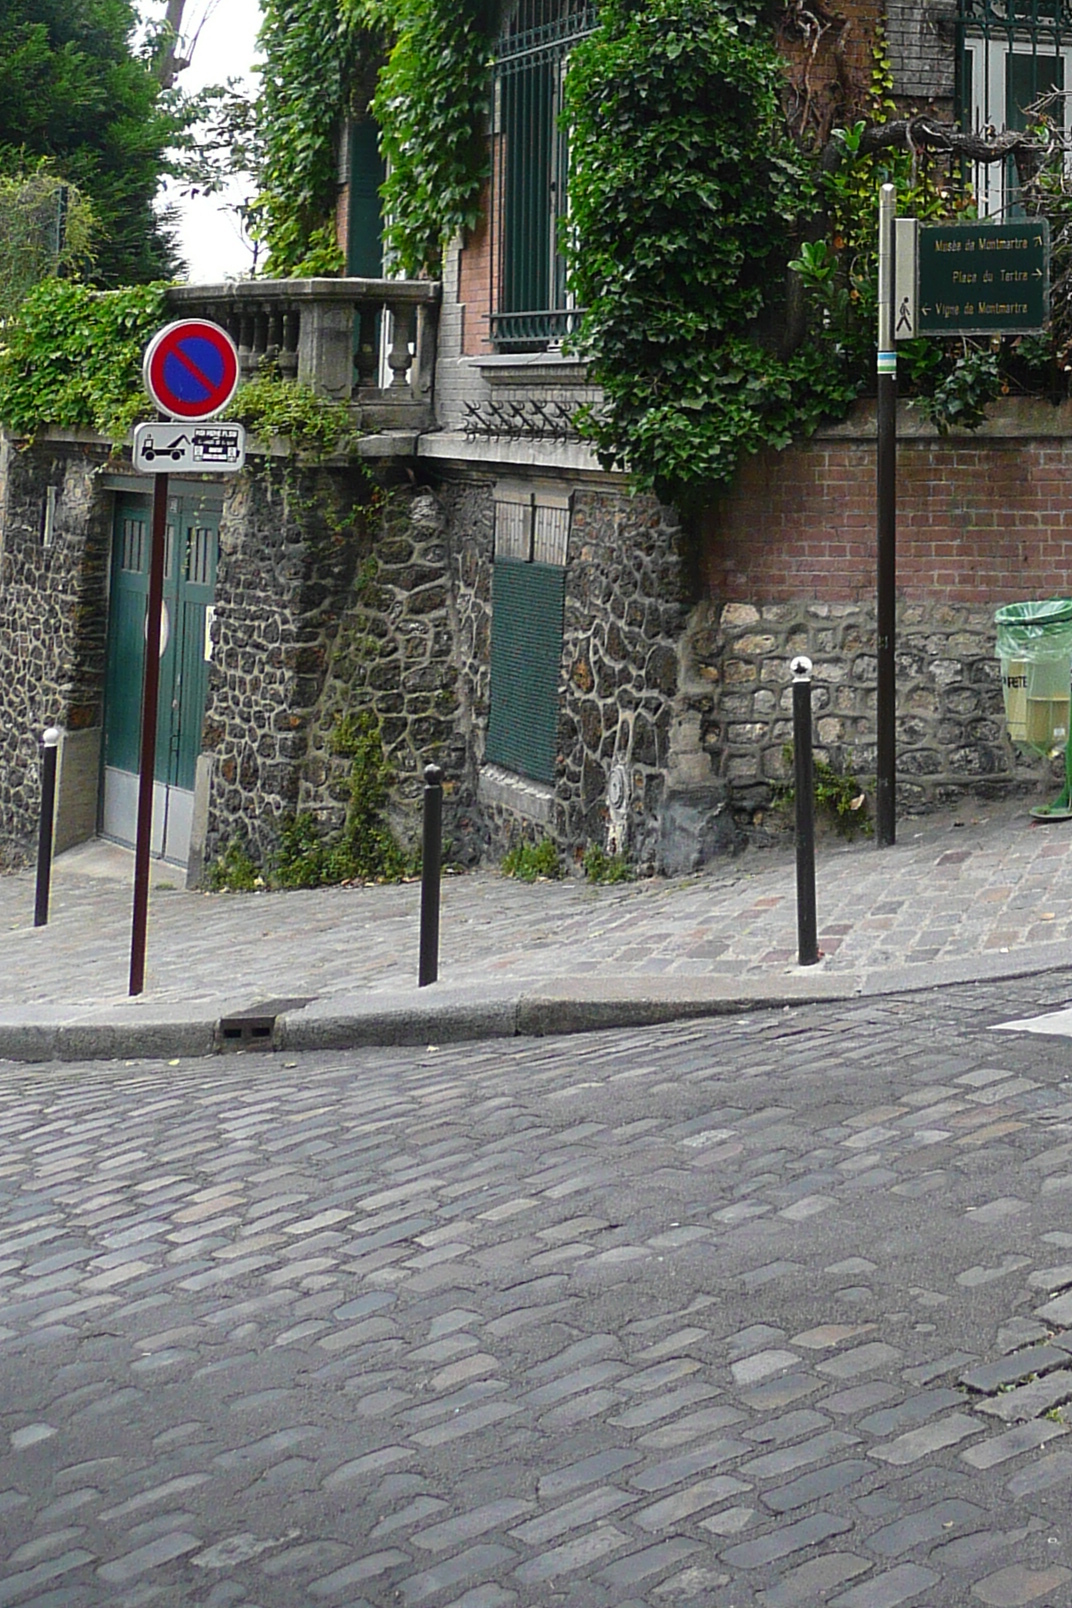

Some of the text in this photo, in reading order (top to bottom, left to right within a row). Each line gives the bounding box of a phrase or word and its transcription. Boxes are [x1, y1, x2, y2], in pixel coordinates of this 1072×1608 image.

[935, 237, 1028, 252] Musée de Montmartre
[952, 269, 1028, 283] Place du Tertre
[935, 301, 1028, 318] Vigne de Montmartre
